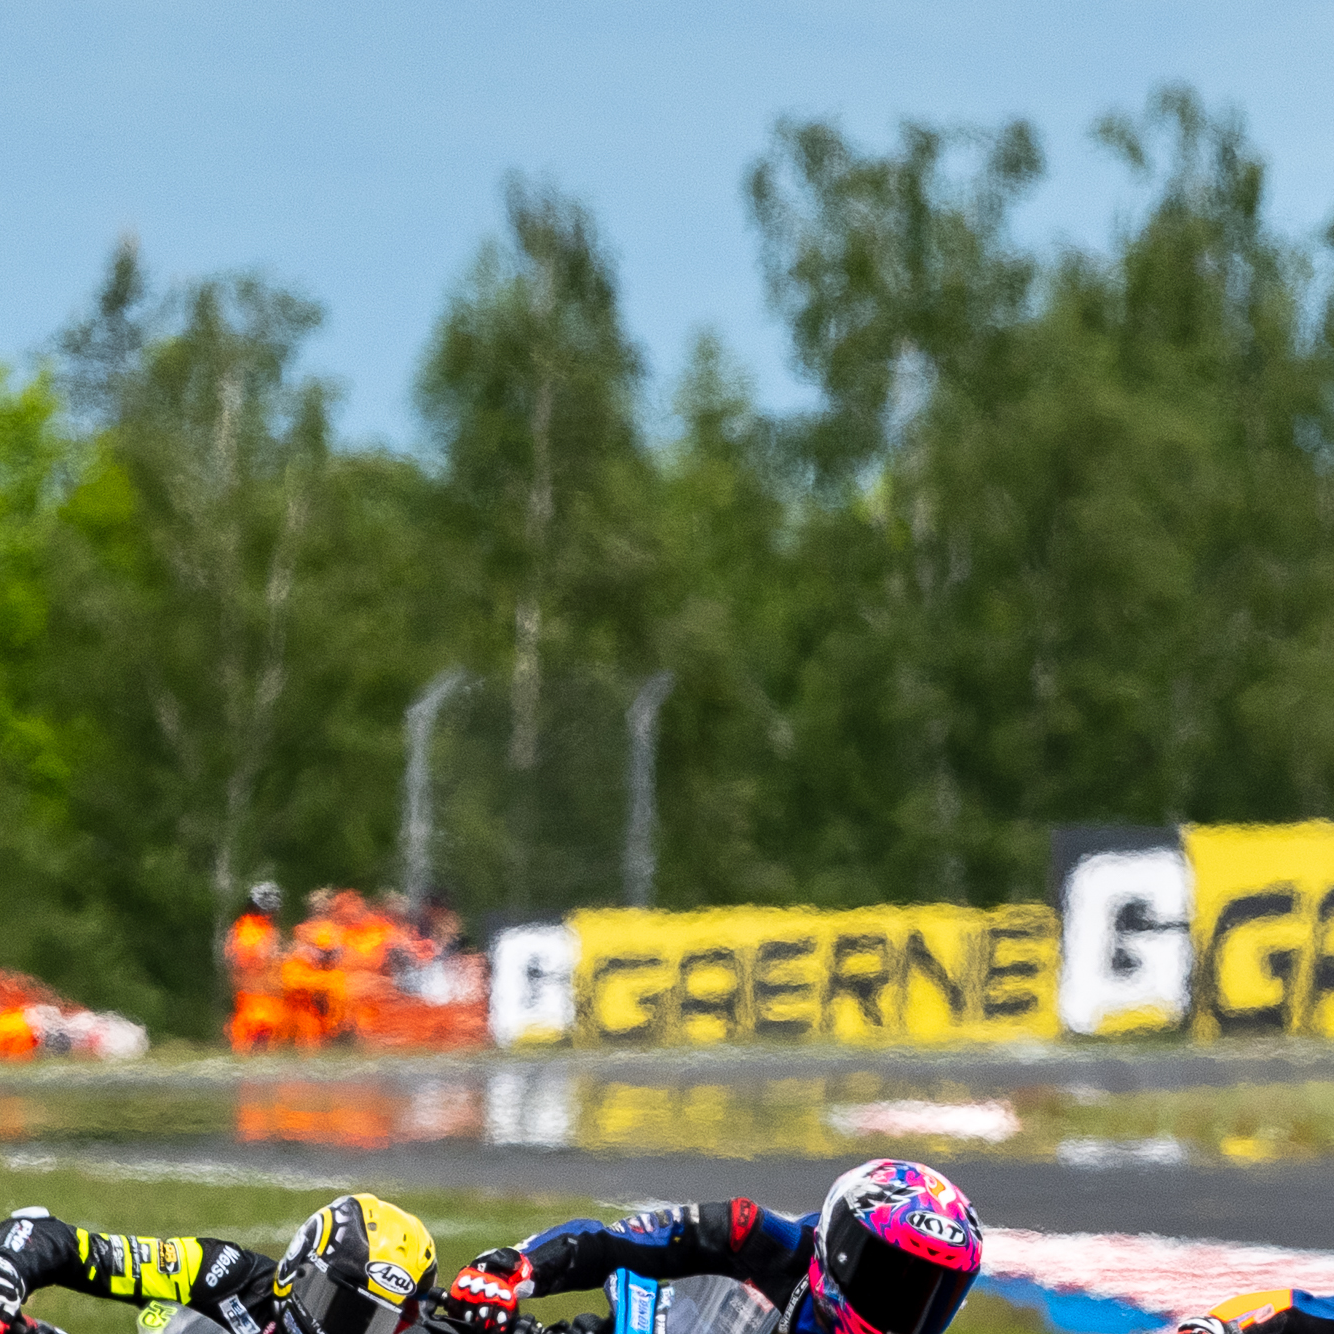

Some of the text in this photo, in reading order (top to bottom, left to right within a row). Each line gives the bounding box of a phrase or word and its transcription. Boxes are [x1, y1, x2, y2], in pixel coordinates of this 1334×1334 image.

[589, 926, 1043, 1044] GAERNE
[914, 1215, 965, 1243] KYT
[205, 1245, 241, 1288] Weise
[369, 1263, 410, 1292] Arai
